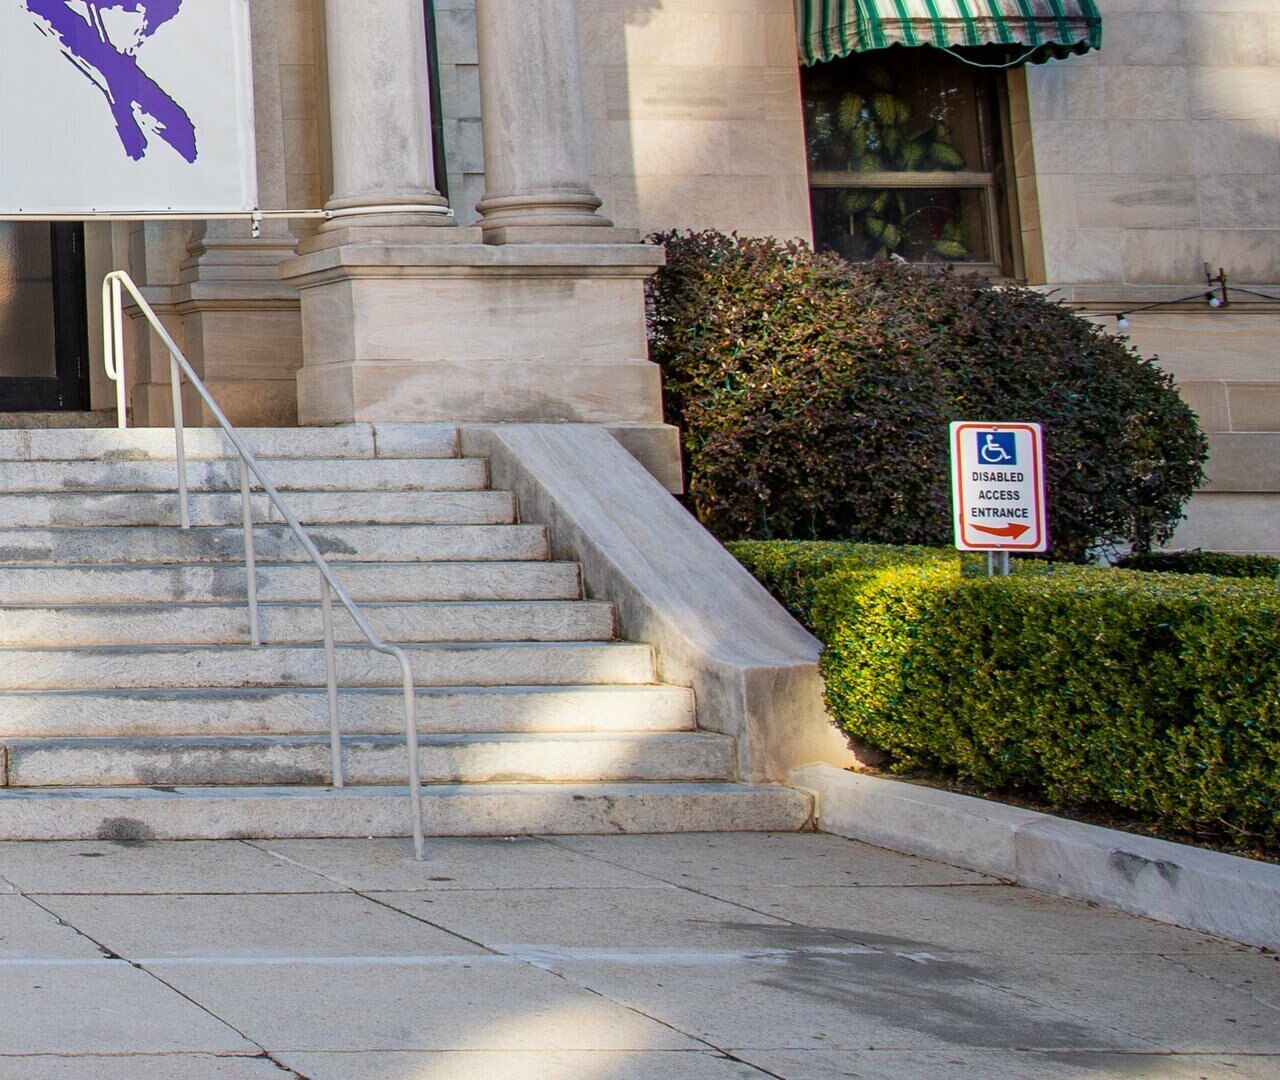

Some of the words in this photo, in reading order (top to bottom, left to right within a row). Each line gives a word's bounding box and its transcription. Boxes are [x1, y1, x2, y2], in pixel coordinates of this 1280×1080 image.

[971, 471, 1024, 482] DISABLED
[978, 490, 1020, 500] ACCESS
[971, 507, 1028, 518] ENTRANCE
